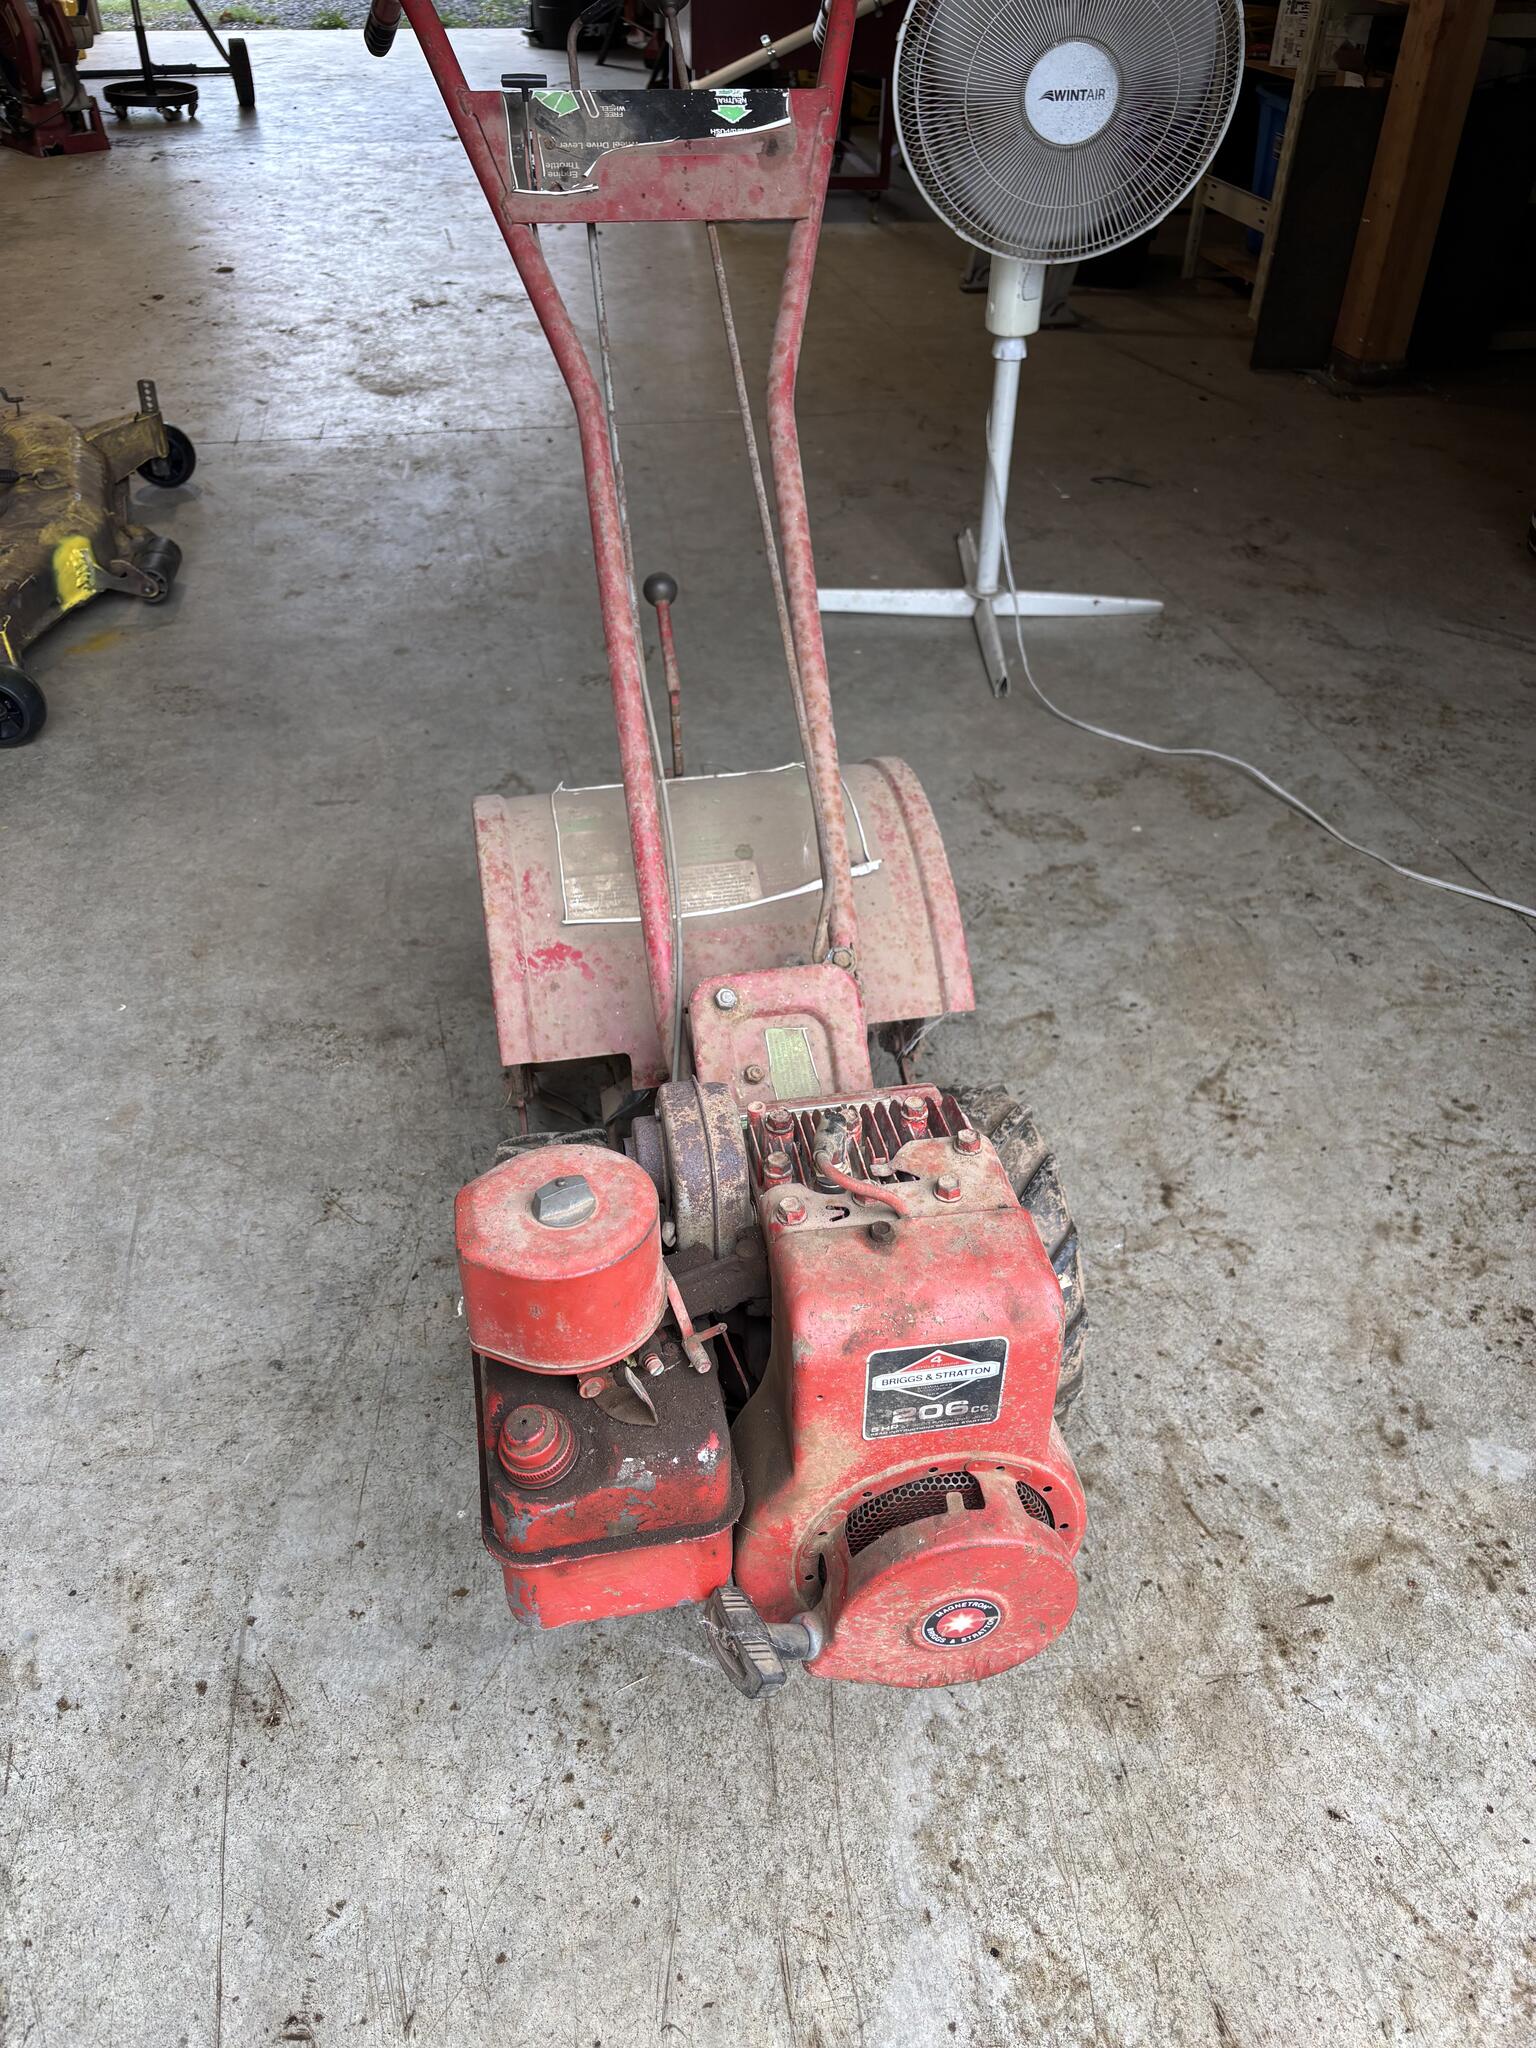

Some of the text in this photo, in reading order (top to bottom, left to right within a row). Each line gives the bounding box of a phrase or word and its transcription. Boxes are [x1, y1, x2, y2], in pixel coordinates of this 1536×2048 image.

[1054, 88, 1106, 102] WINTAIR
[714, 97, 748, 105] NEUTRAL
[559, 142, 584, 150] Lever
[586, 141, 609, 149] Drive
[545, 161, 580, 169] Throttle
[930, 1355, 943, 1364] 4
[881, 1366, 991, 1387] BRIGGS & STRATTON
[892, 1400, 969, 1424] 206
[936, 1601, 990, 1618] MAGNETRON
[926, 1627, 947, 1643] BRIGGS
